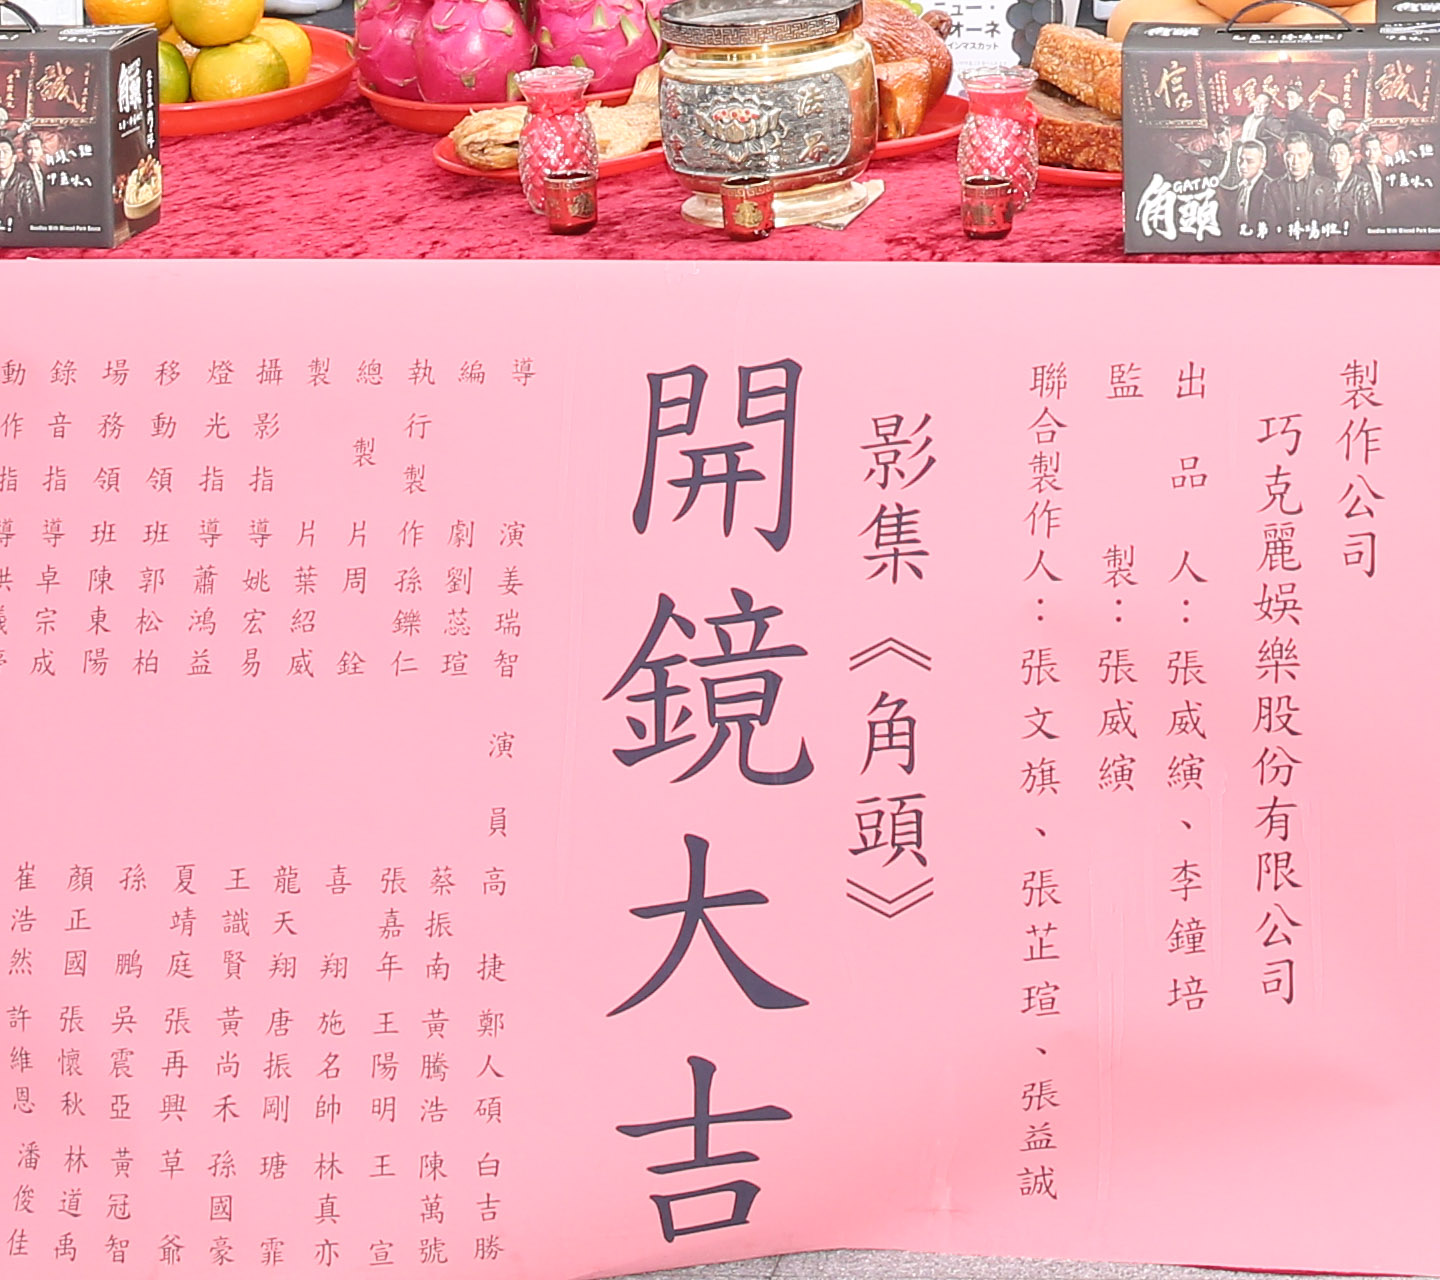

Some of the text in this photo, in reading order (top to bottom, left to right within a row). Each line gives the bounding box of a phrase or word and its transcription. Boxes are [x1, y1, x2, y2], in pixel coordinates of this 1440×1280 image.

[1136, 174, 1222, 241] 角頭
[1172, 176, 1219, 192] GATAO
[31, 360, 77, 676] 錄音指導 卓宗成
[83, 359, 129, 676] 場務領班 陳東陽
[133, 360, 180, 675] 移動領班 郭松柏
[187, 360, 234, 675] 燈光指導 蕭鴻益
[242, 358, 283, 677] 攝影指導 姚宏易
[287, 357, 330, 678] 製片 葉紹威
[337, 359, 383, 675] 總製片 周銓
[399, 358, 435, 548] 執行製作
[441, 360, 485, 676] 編劇 劉蕊瑄
[494, 358, 536, 678] 導演 姜瑞智
[1336, 359, 1385, 578] 製作公司
[603, 358, 816, 1245] 開鏡大吉
[1252, 414, 1303, 1005] 巧克麗娛樂股份有限公司
[6, 861, 37, 1113] 崔浩然 許維恩
[58, 864, 93, 1116] 顏正國 張懷秋
[110, 1005, 137, 1119] 吳震亞
[159, 864, 196, 1122] 夏靖庭 張再興
[214, 868, 250, 1123] 王識賢 黃尚禾
[263, 865, 301, 1123] 龍天翔 唐振剛
[316, 1009, 345, 1124] 施名帥
[372, 867, 407, 1123] 張嘉年 王陽明
[421, 866, 456, 1122] 蔡振南 黃騰浩
[474, 1009, 504, 1123] 鄭人碩
